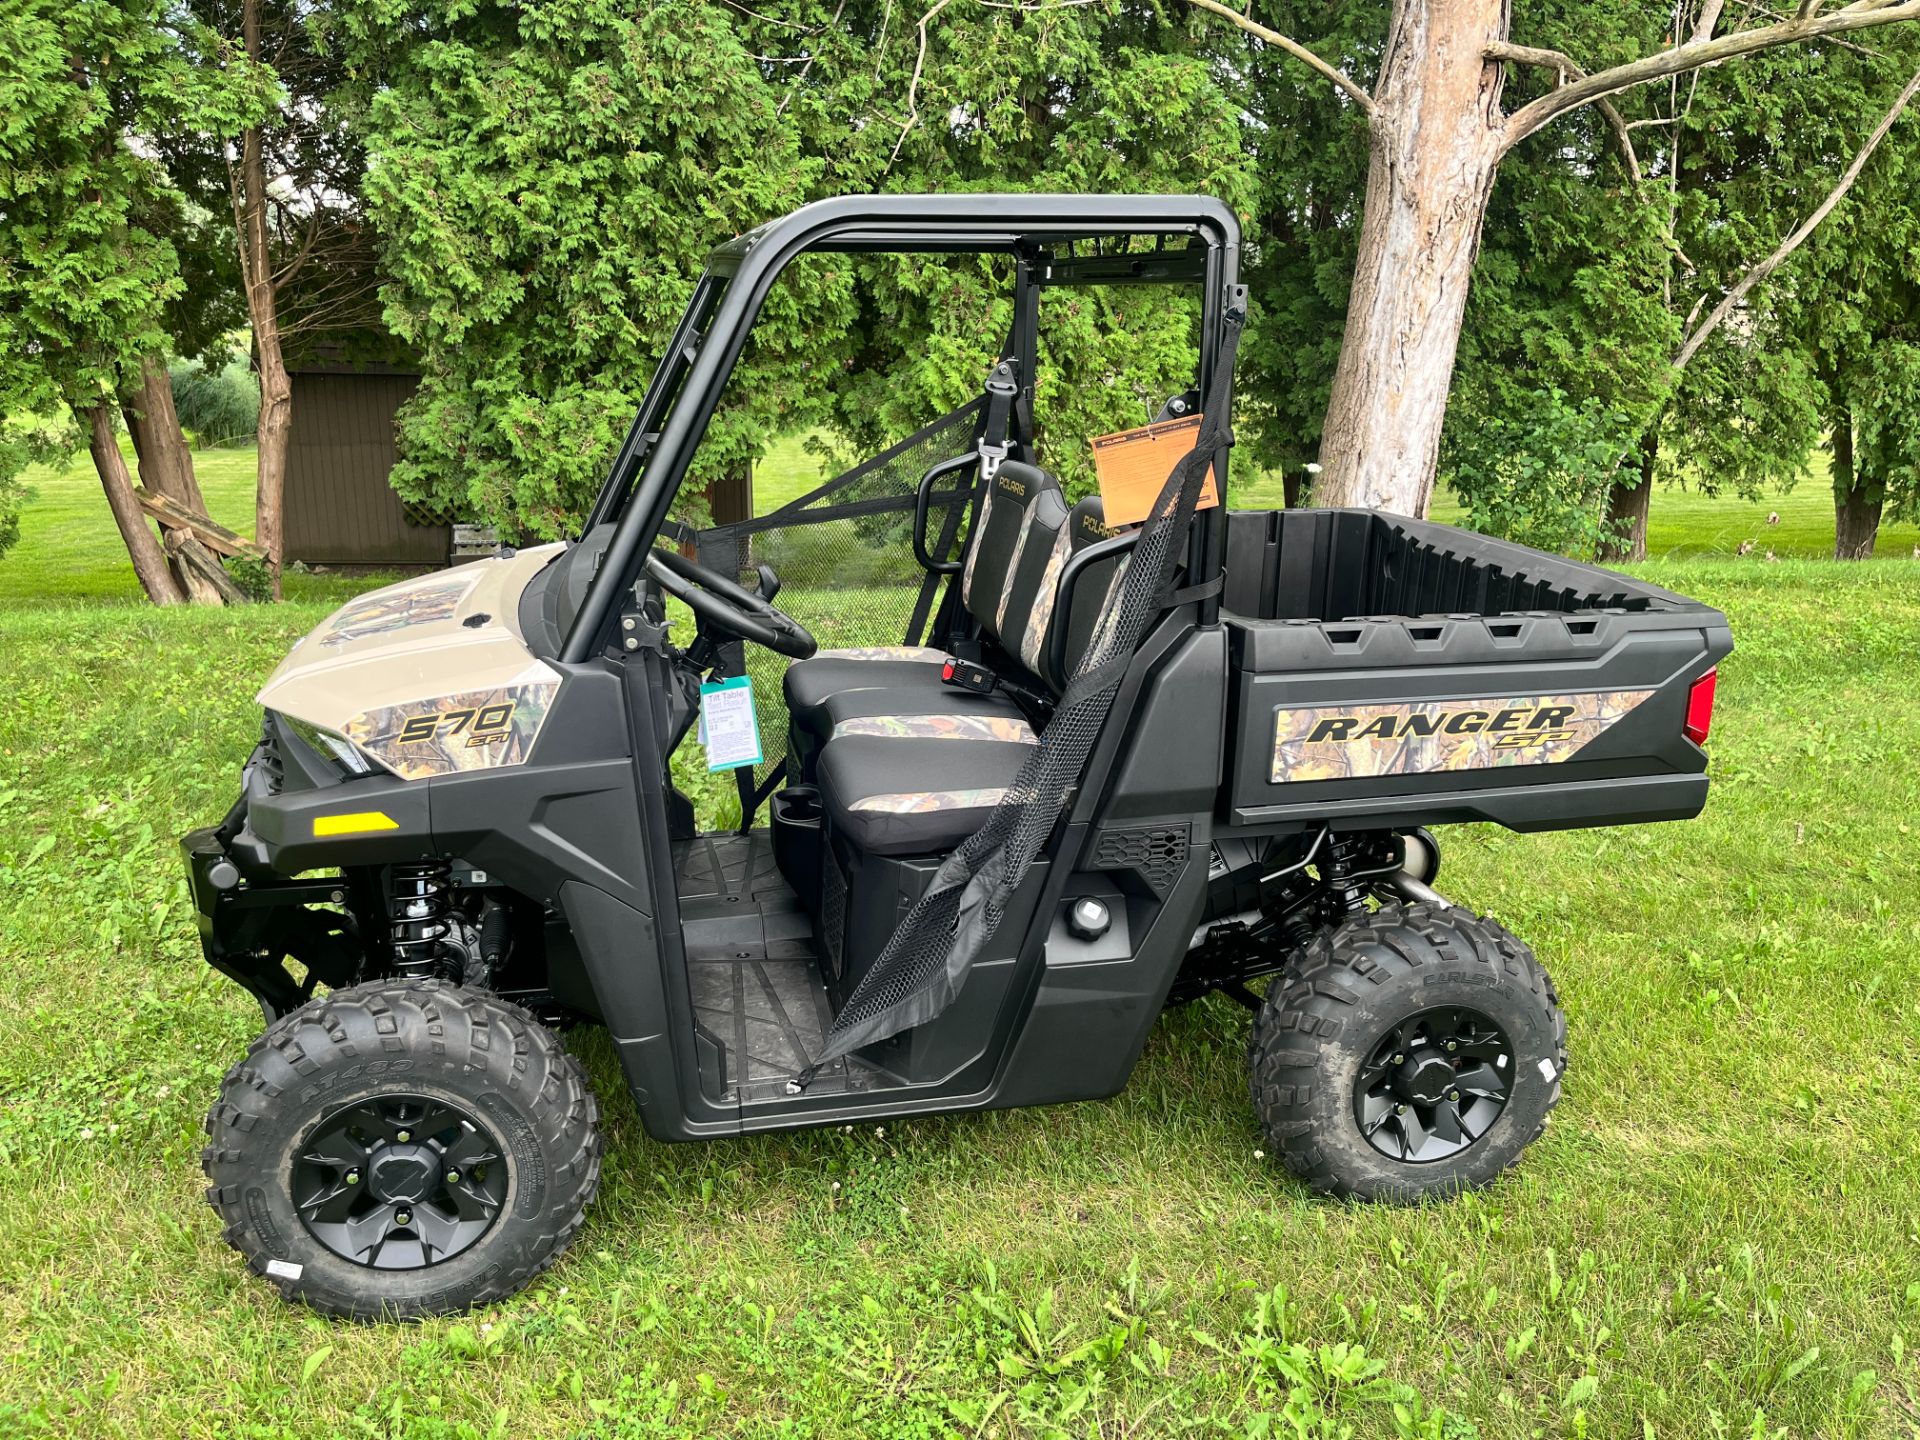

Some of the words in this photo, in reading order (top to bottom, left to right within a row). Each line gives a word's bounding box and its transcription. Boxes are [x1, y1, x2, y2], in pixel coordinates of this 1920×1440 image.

[999, 476, 1025, 496] POLARIS
[1083, 515, 1121, 539] POLARIS
[708, 694, 721, 703] Tilt
[723, 691, 744, 701] Table
[397, 703, 515, 745] 570
[1306, 704, 1578, 744] RANGER
[465, 731, 511, 748] EFI
[1491, 729, 1578, 750] SP
